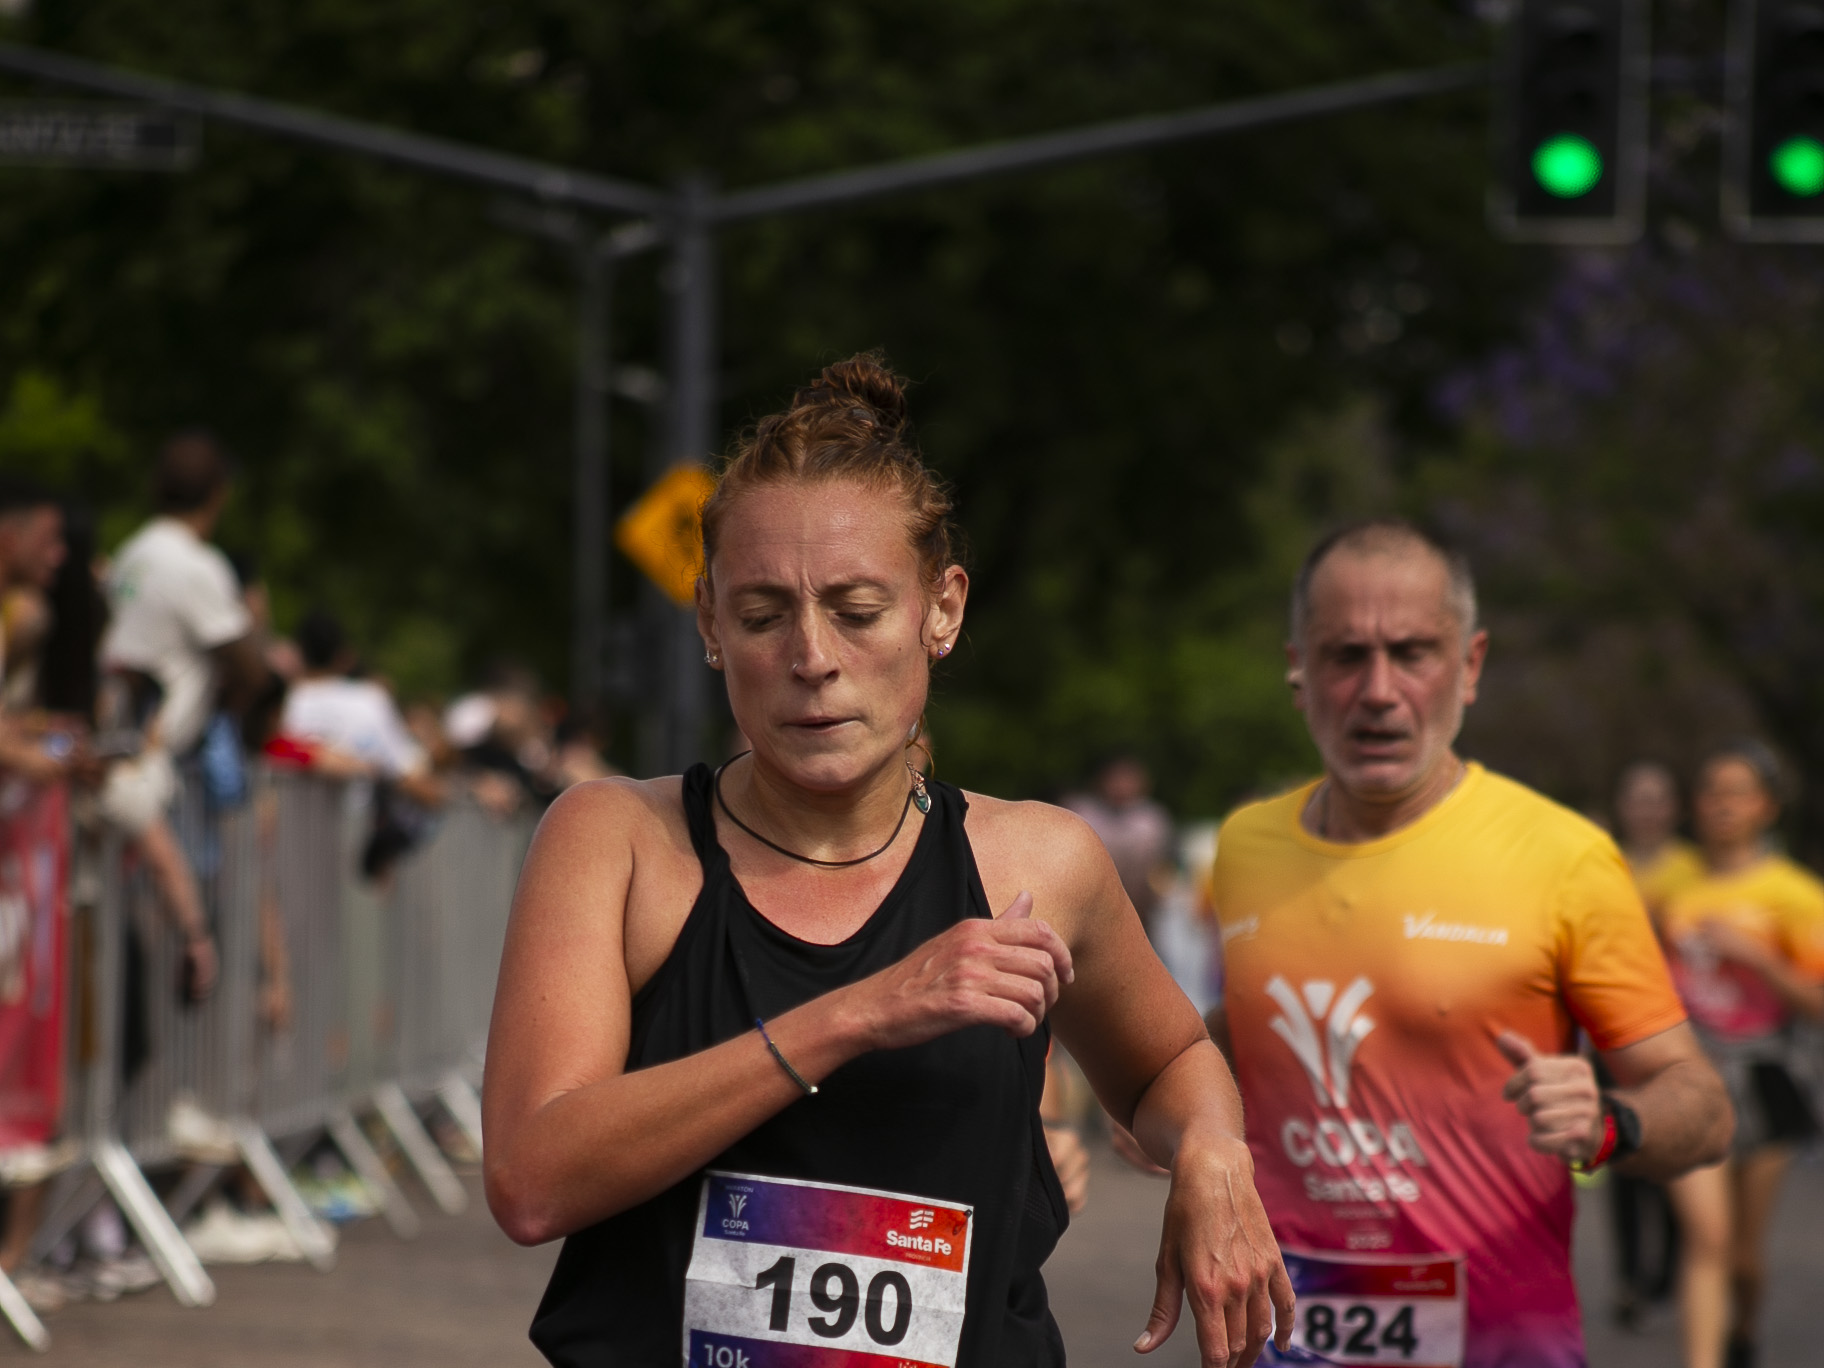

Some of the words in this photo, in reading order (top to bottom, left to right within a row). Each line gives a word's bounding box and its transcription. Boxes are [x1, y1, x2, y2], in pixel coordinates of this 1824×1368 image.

[1282, 1117, 1427, 1168] COPA
[722, 1218, 749, 1231] COPA
[886, 1230, 933, 1252] Santa
[934, 1238, 952, 1256] Fe
[755, 1255, 912, 1346] 190
[1304, 1304, 1419, 1358] 824
